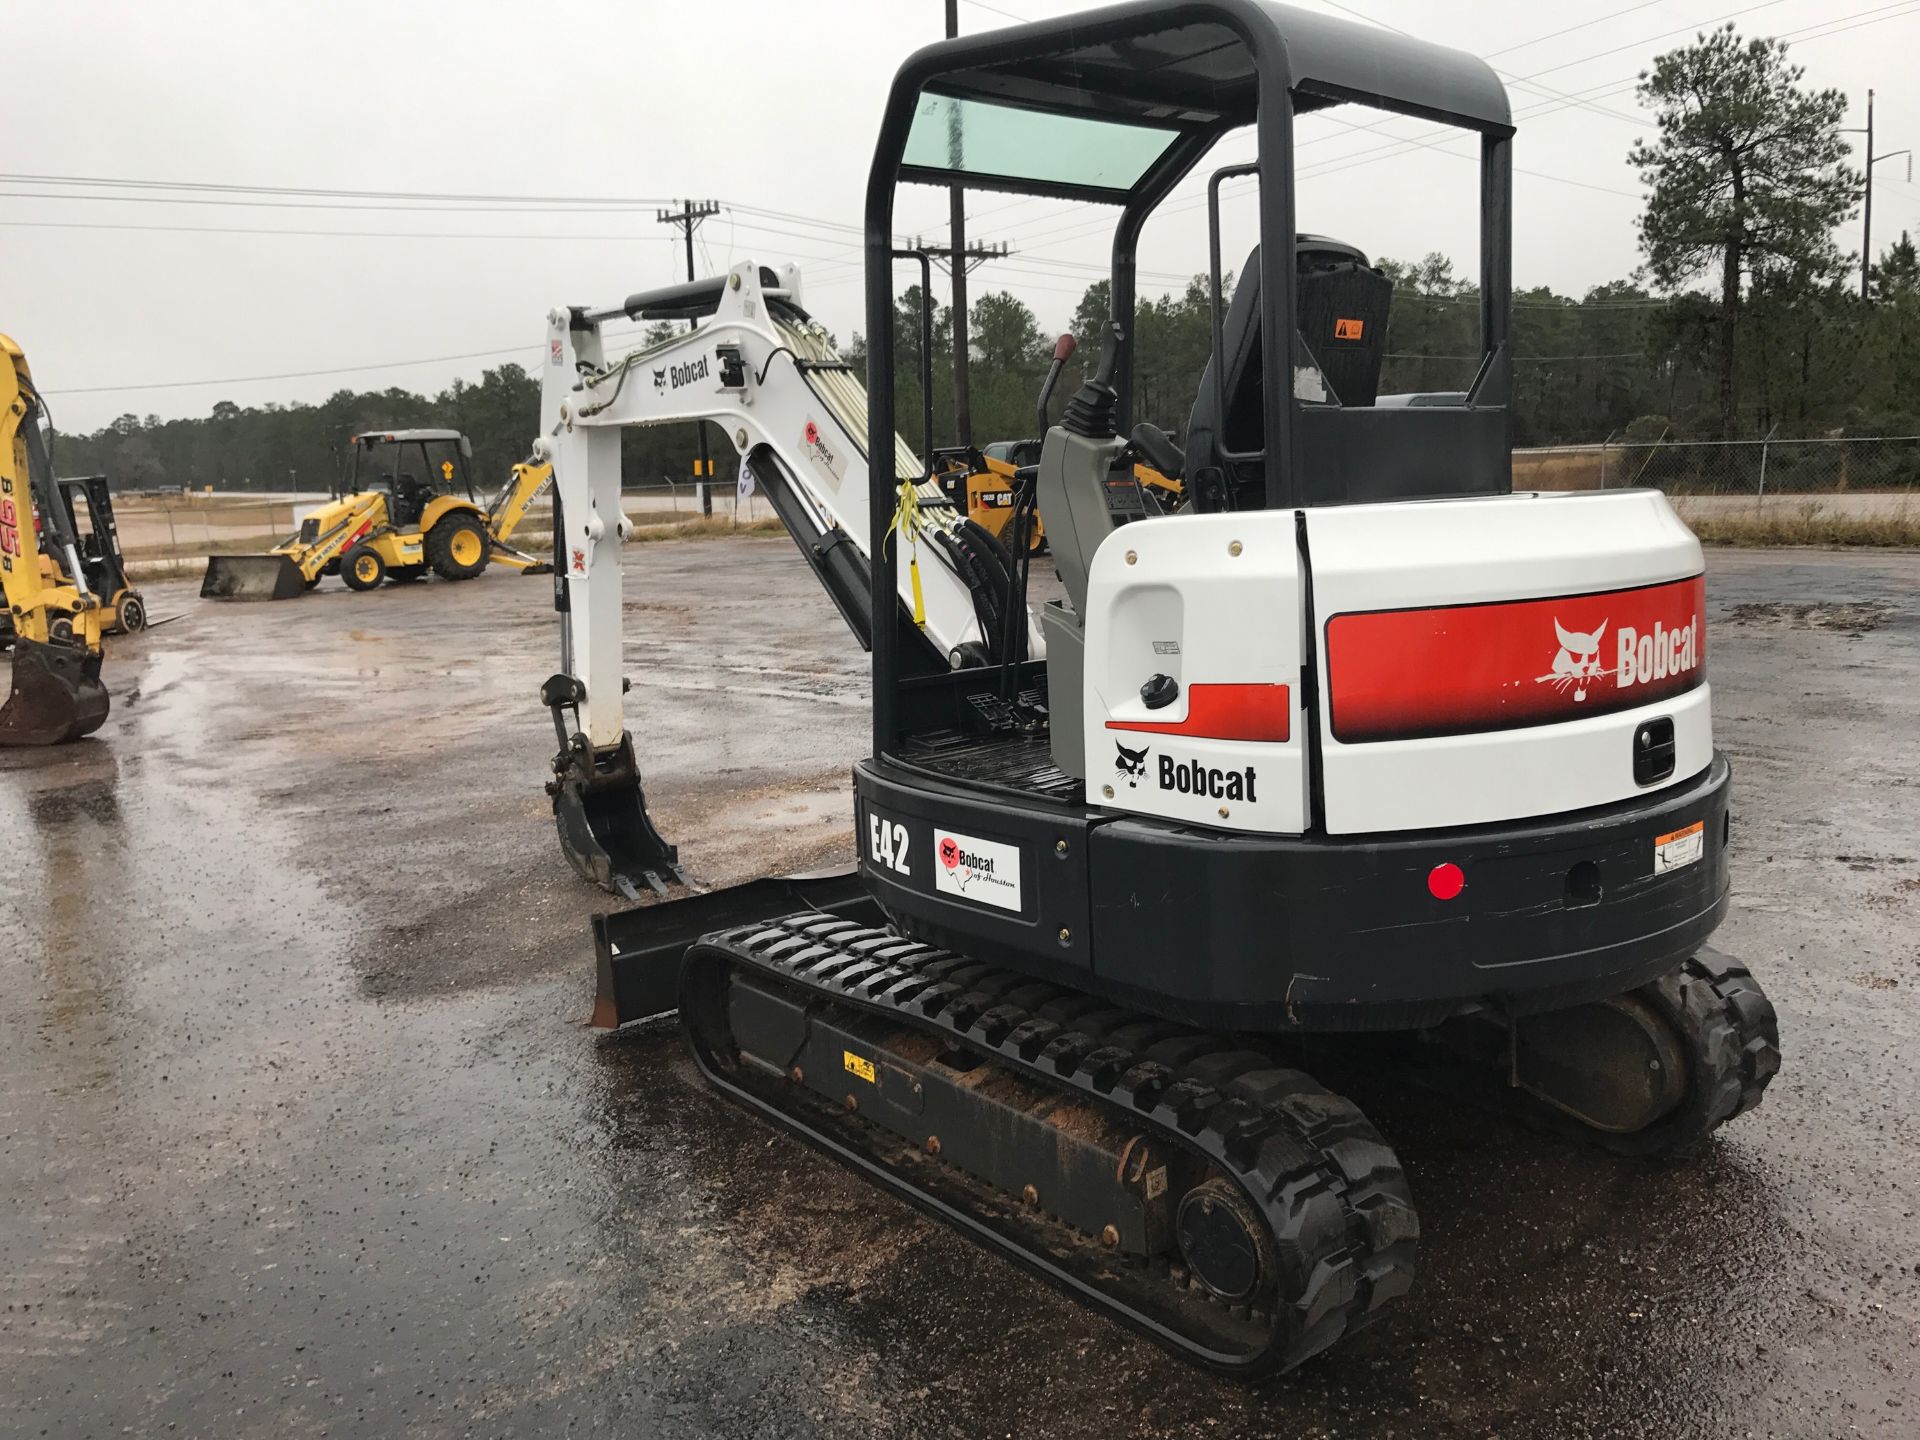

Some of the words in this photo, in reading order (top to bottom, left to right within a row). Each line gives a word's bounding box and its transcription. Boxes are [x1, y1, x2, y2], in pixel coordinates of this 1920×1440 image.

[670, 354, 709, 390] Bobcat
[815, 436, 834, 464] Bobcat
[997, 493, 1012, 506] CAT
[1617, 614, 1697, 689] Bobcat
[1158, 754, 1257, 803] Bobcat
[869, 812, 911, 876] E42
[959, 850, 994, 873] Bobcat
[973, 872, 984, 881] of
[983, 873, 1015, 888] Houston
